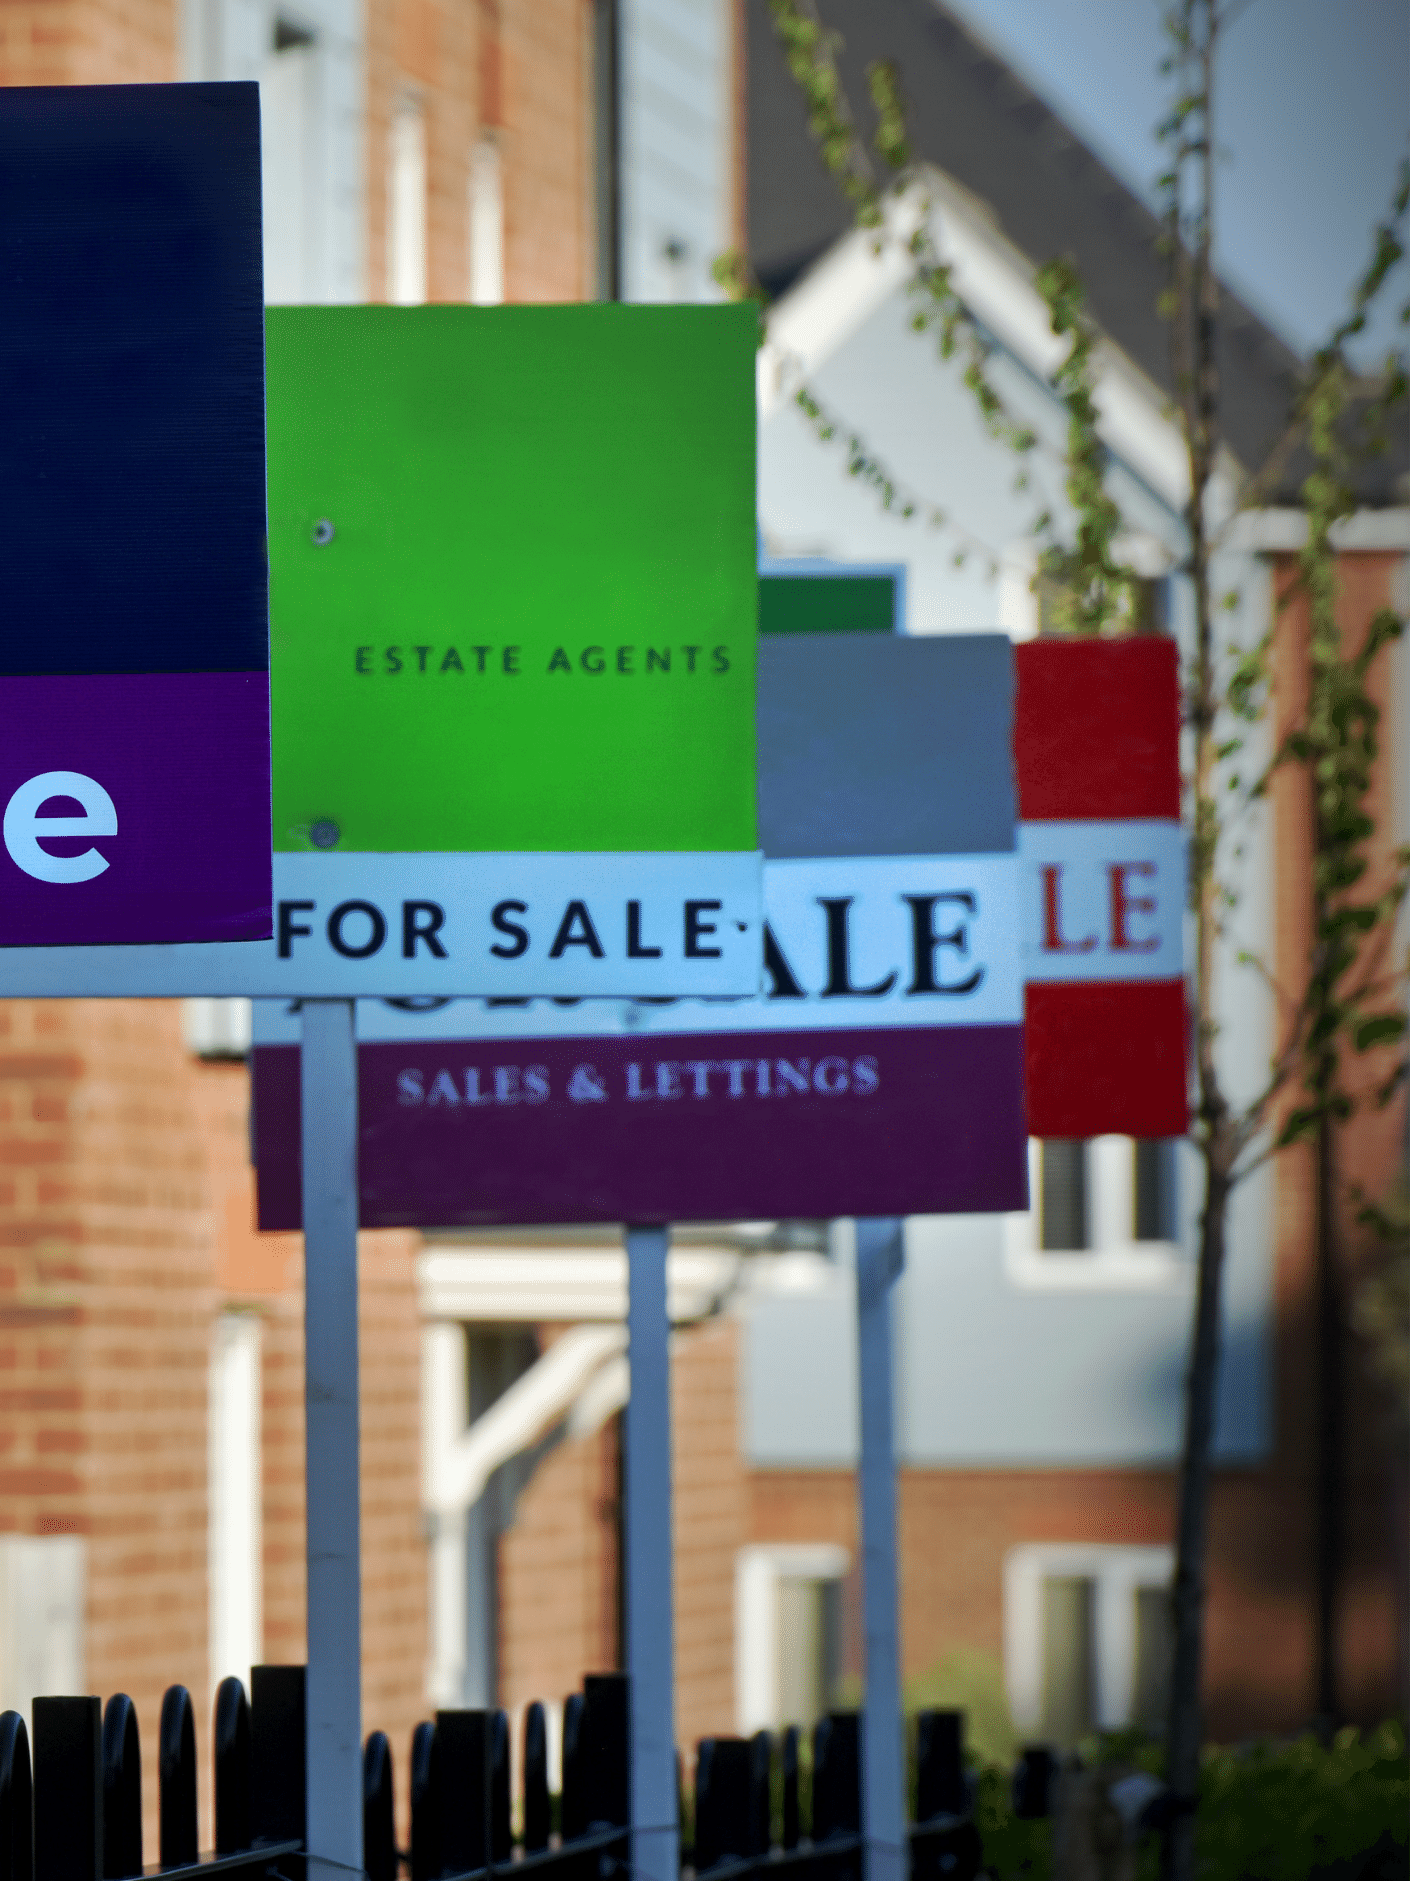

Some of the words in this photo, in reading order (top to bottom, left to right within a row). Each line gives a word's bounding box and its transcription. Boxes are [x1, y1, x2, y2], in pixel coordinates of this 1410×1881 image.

[353, 645, 522, 676] ESTATE
[545, 644, 733, 676] AGENTS
[276, 898, 448, 960] FOR
[488, 898, 724, 960] SALE
[396, 1066, 551, 1105] SALES
[566, 1064, 607, 1103] &
[624, 1056, 880, 1100] LETTINGS
